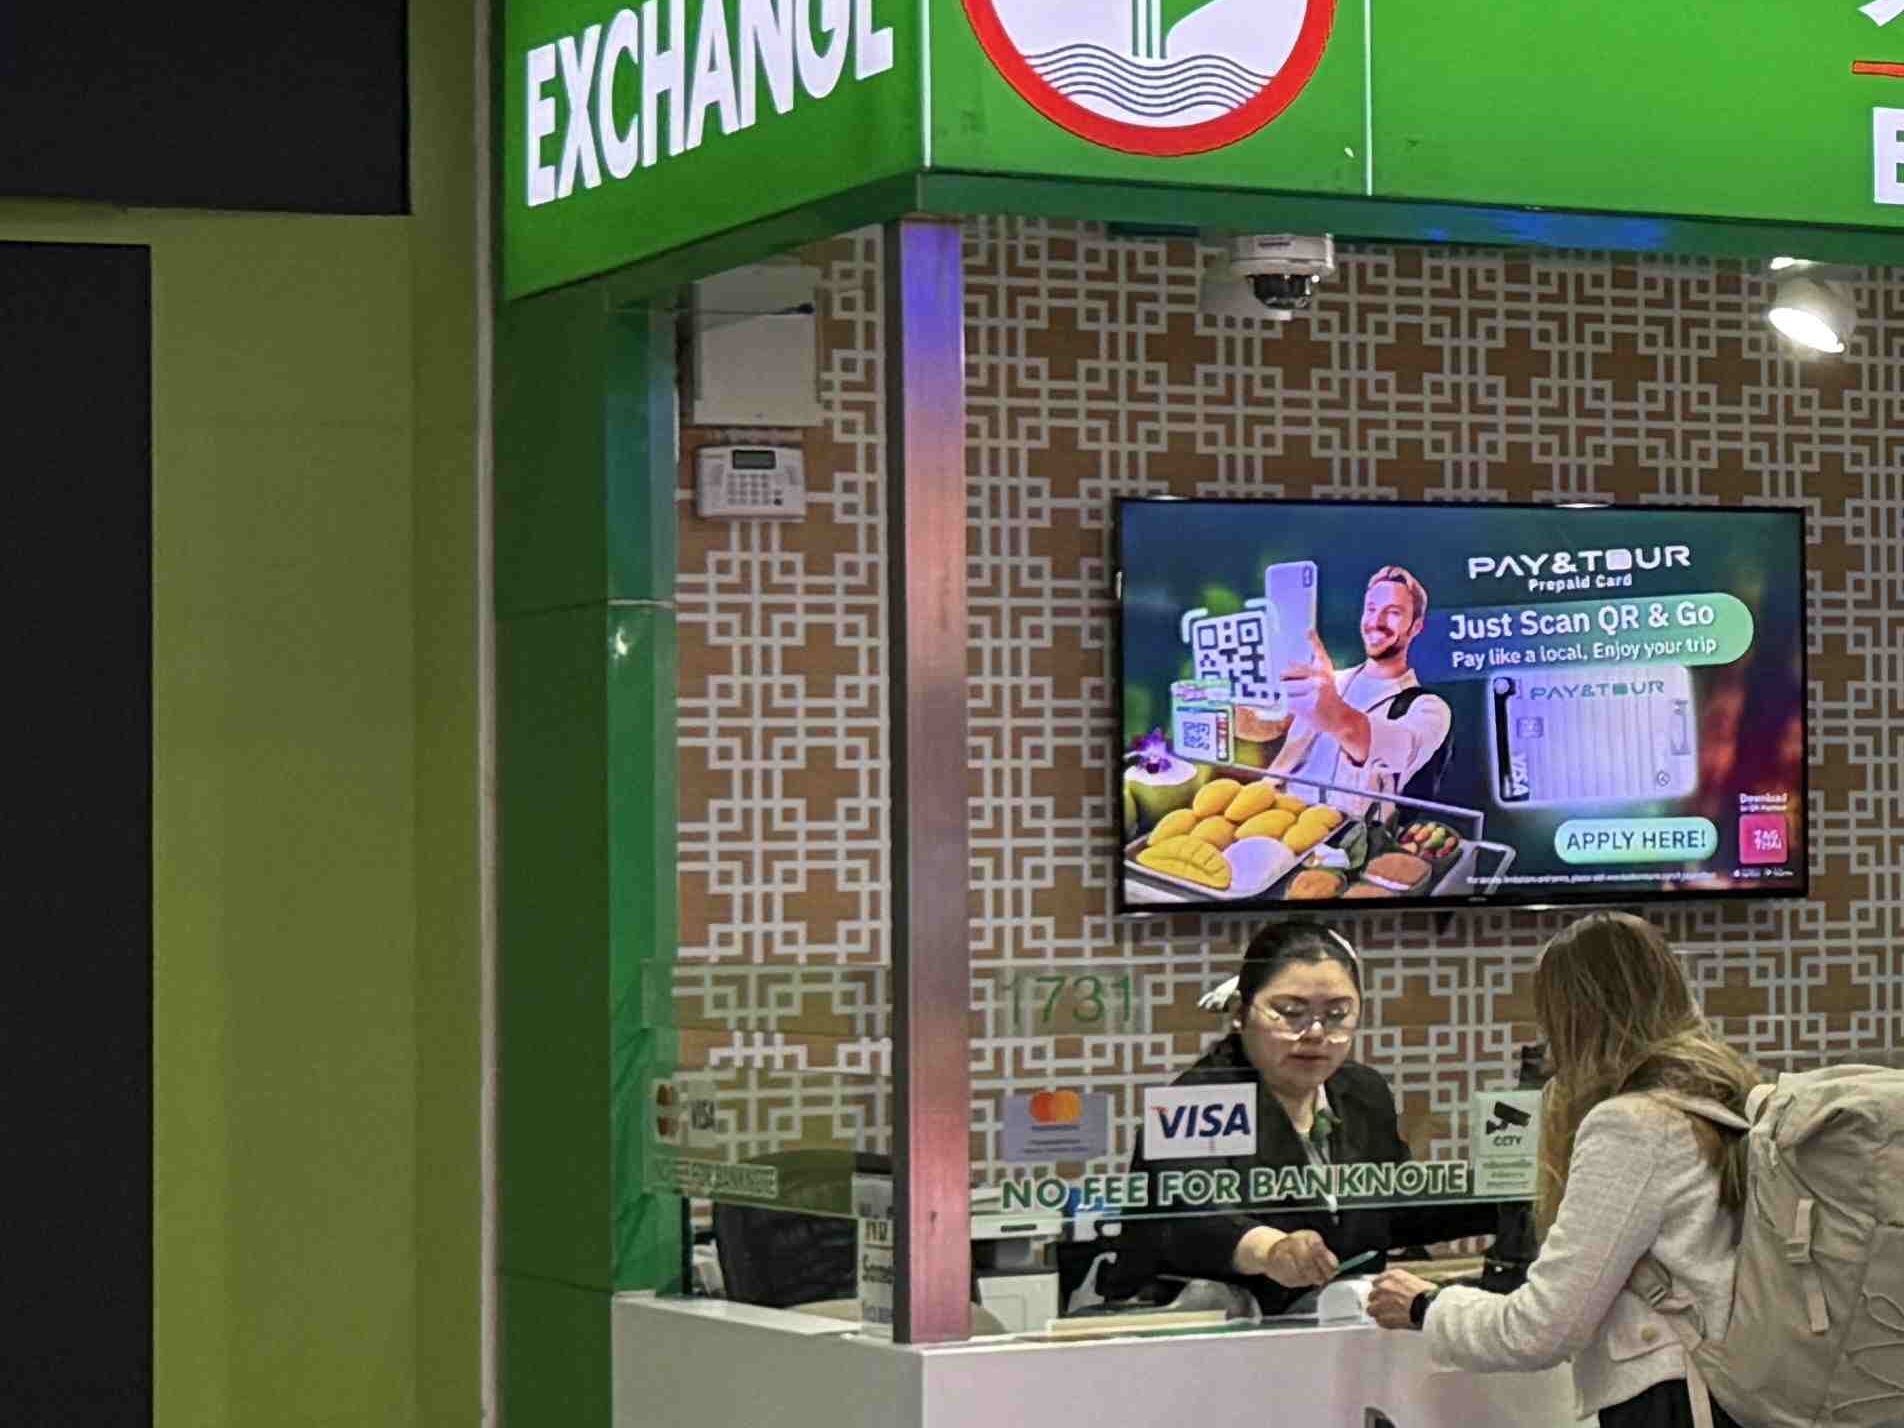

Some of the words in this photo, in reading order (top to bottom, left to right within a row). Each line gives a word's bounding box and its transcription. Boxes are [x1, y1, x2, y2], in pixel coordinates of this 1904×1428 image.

[1528, 575, 1590, 593] Prepaid
[1595, 573, 1632, 588] Card
[1449, 612, 1513, 640] Just
[1520, 610, 1590, 636] Scan
[1598, 604, 1640, 635] QR
[1648, 603, 1669, 628] &
[1676, 601, 1715, 626] Go
[1452, 651, 1485, 670] Pay
[1488, 647, 1522, 665] like
[1524, 649, 1537, 663] a
[1593, 641, 1640, 661] Enjoy
[1644, 639, 1682, 659] your
[1685, 636, 1717, 655] trip
[1566, 831, 1635, 851] APPLY
[1642, 829, 1707, 850] HERE!
[1151, 1102, 1252, 1140] VISA
[1000, 1178, 1069, 1211] NO
[1081, 1172, 1149, 1209] FEE
[1157, 1169, 1242, 1206] FOR
[1250, 1160, 1468, 1202] BANKNOTE
